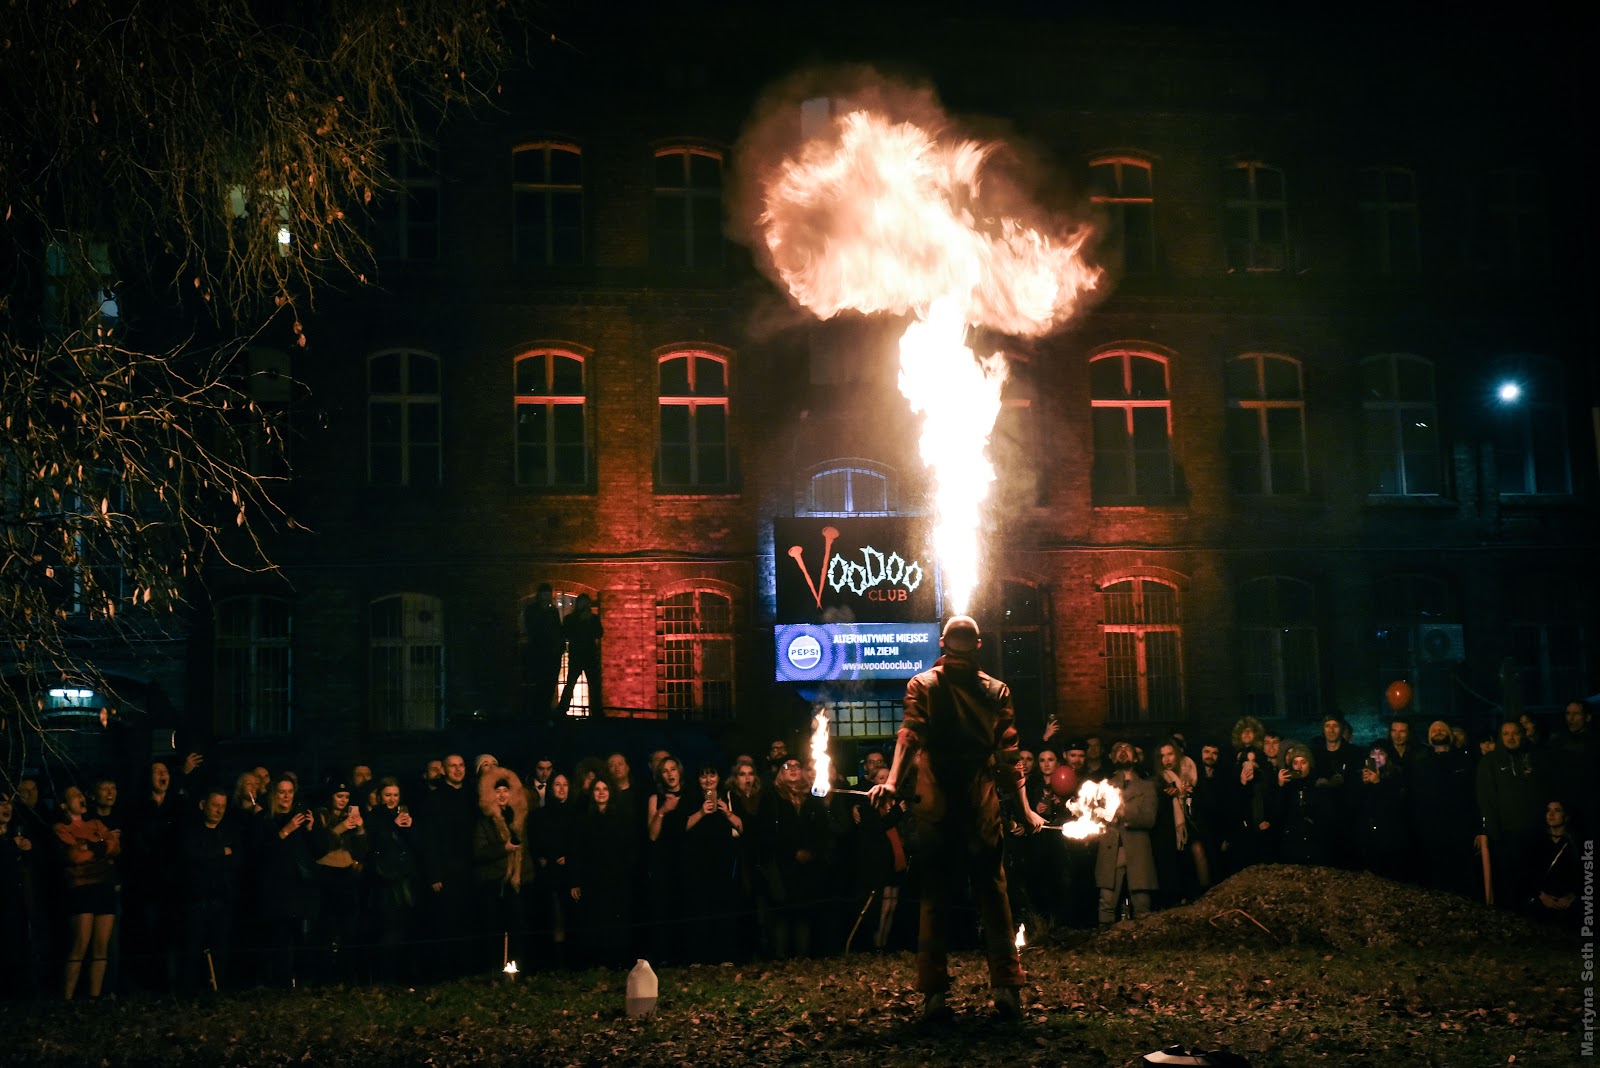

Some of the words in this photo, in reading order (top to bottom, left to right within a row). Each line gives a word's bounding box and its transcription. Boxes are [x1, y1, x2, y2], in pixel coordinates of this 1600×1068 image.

[868, 589, 908, 602] CLUB
[833, 633, 894, 644] ALTERNATYWNE
[896, 633, 929, 643] MIEJSCE
[864, 646, 876, 656] NA
[877, 646, 899, 656] ZIEMI
[842, 660, 922, 671] www.voodooclub.pl
